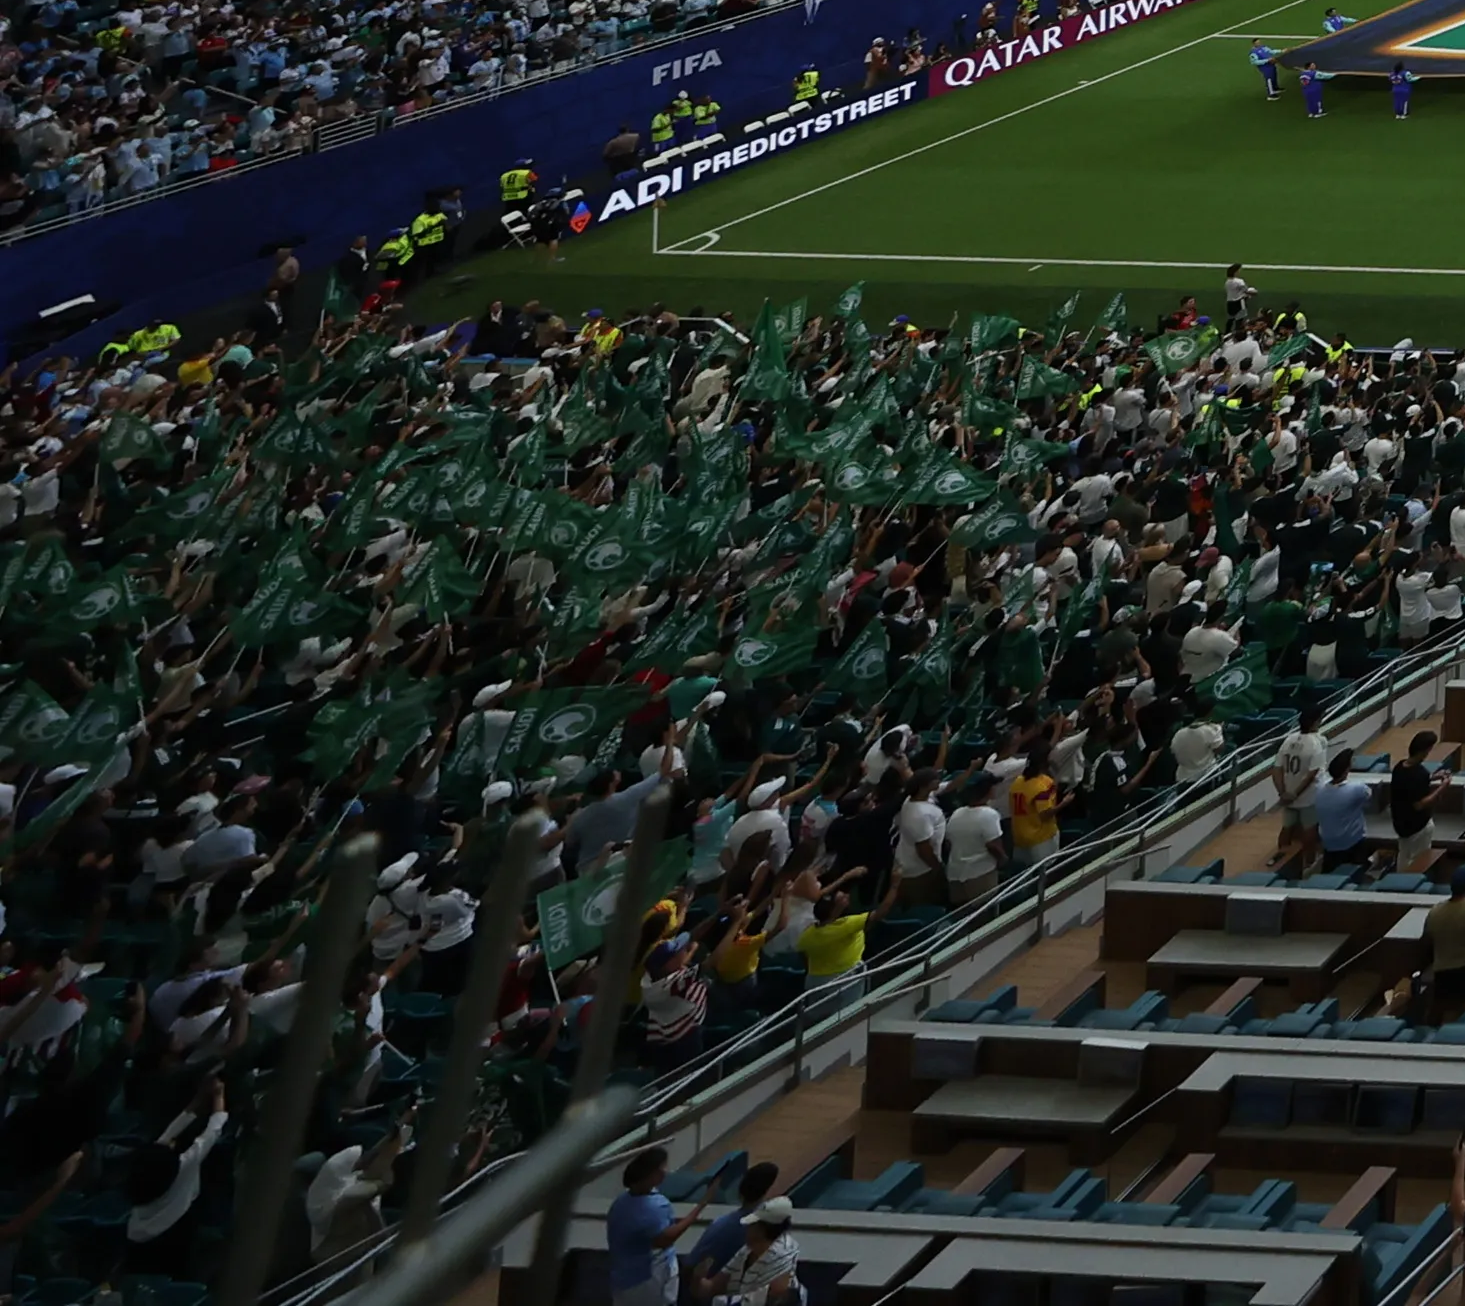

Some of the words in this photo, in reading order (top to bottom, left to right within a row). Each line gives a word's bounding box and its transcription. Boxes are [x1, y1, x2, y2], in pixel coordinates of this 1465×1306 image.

[652, 49, 723, 86] FIFA
[944, 19, 1066, 87] QATAR
[598, 166, 683, 221] ADI
[692, 80, 917, 182] PREDICTSTREET
[504, 706, 537, 755] SAUDI
[1284, 754, 1300, 775] 10
